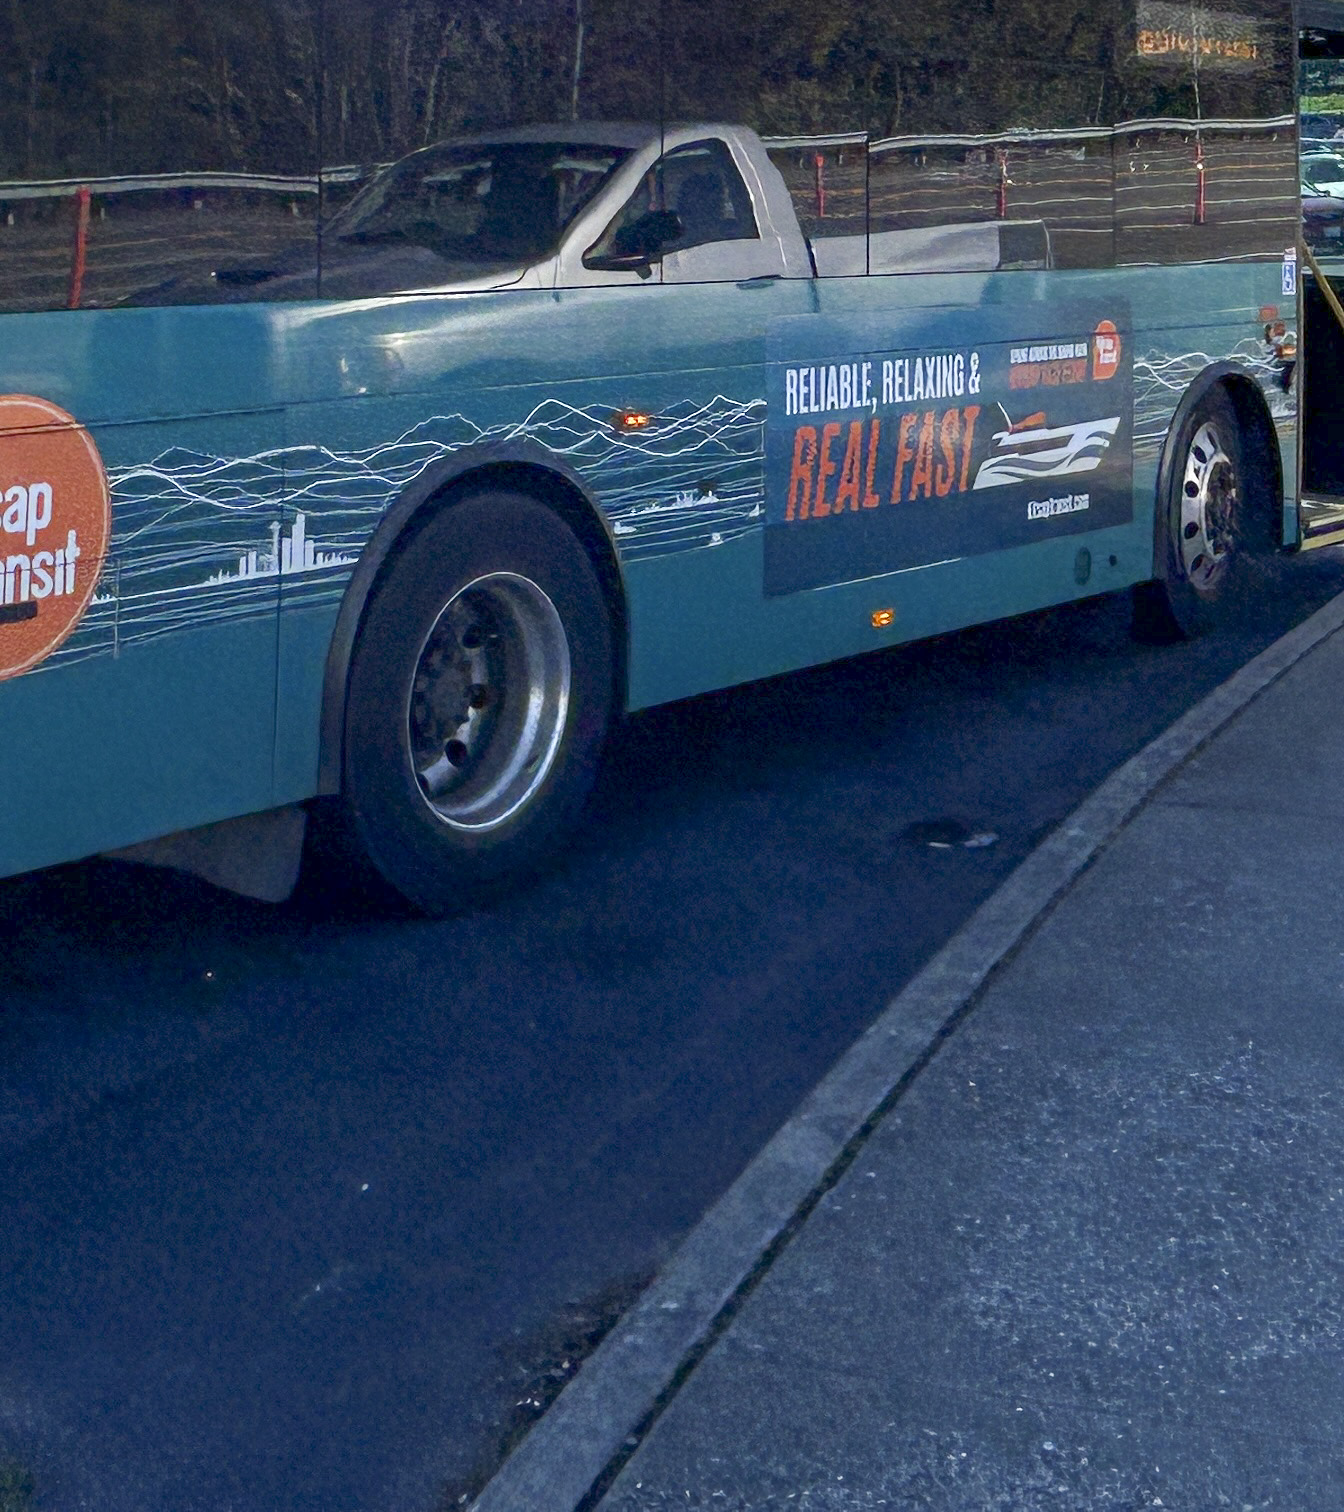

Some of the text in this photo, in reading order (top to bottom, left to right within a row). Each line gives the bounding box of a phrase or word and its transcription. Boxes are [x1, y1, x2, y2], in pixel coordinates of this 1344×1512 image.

[786, 361, 877, 415] RELIABLE,
[882, 353, 964, 404] RELAXING
[969, 352, 980, 394] &
[785, 405, 981, 521] REAL FAST
